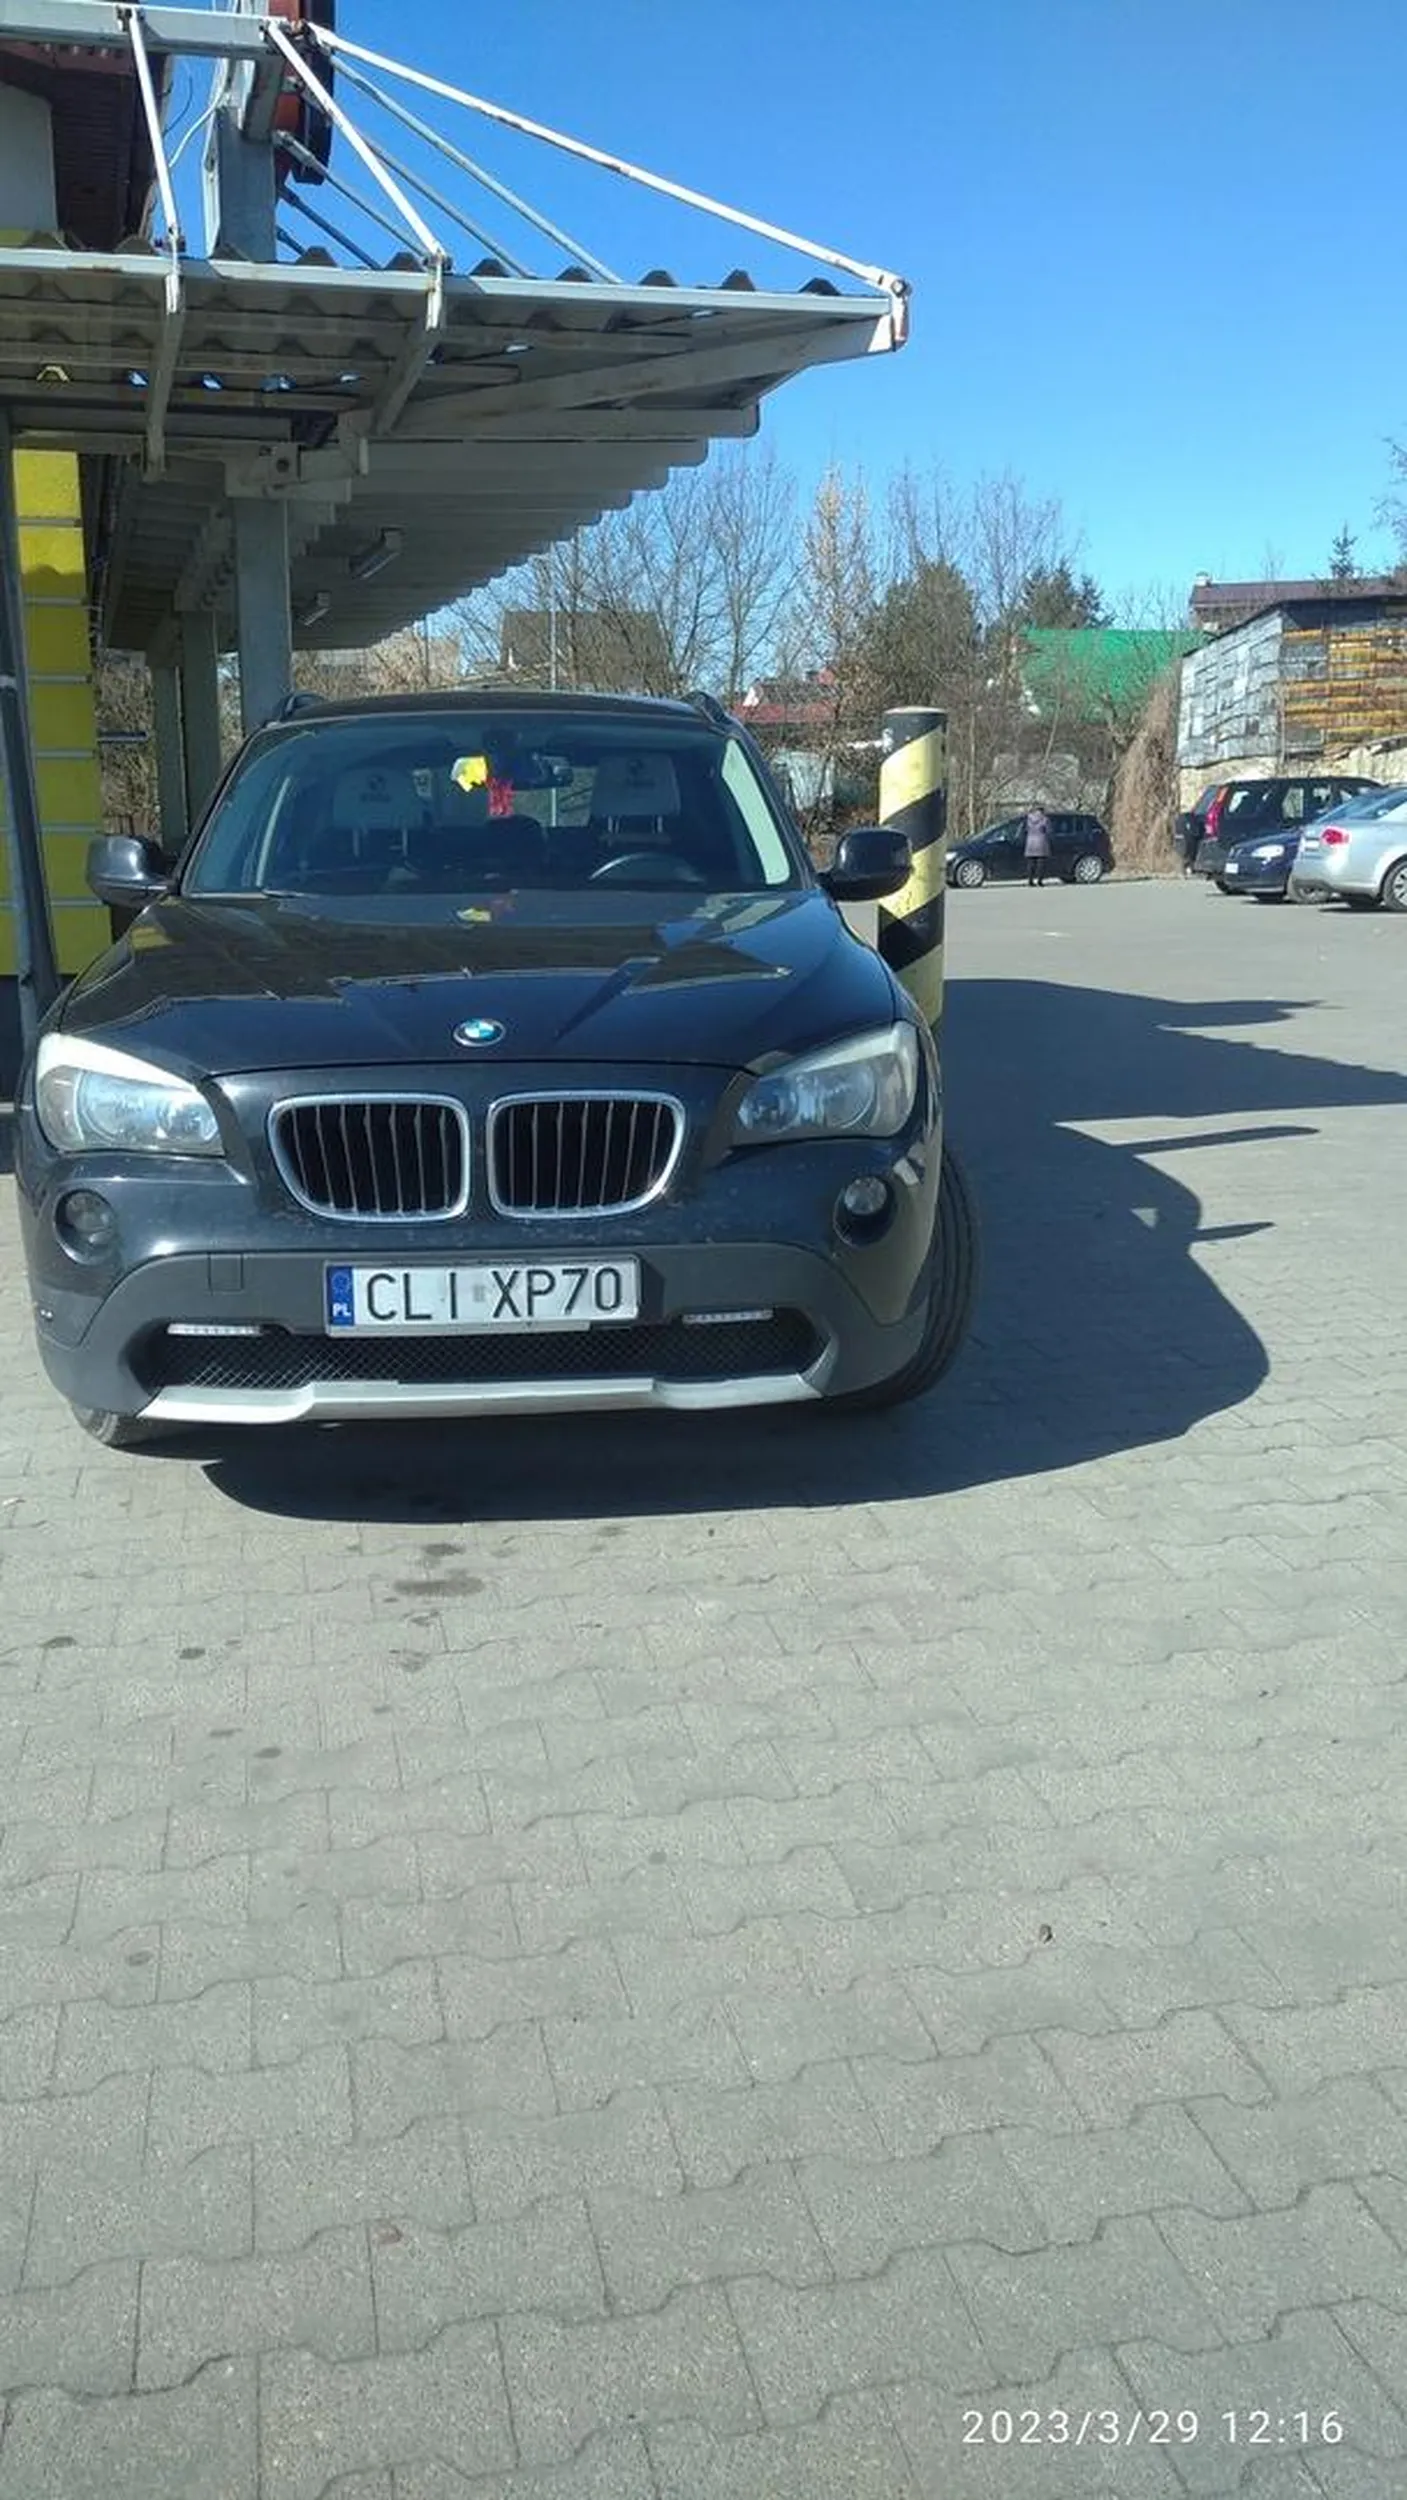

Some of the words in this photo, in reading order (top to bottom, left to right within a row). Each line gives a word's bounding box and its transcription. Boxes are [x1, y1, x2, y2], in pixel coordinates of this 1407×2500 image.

[332, 1302, 352, 1317] PL
[366, 1272, 457, 1321] CLI
[491, 1266, 622, 1319] XP70
